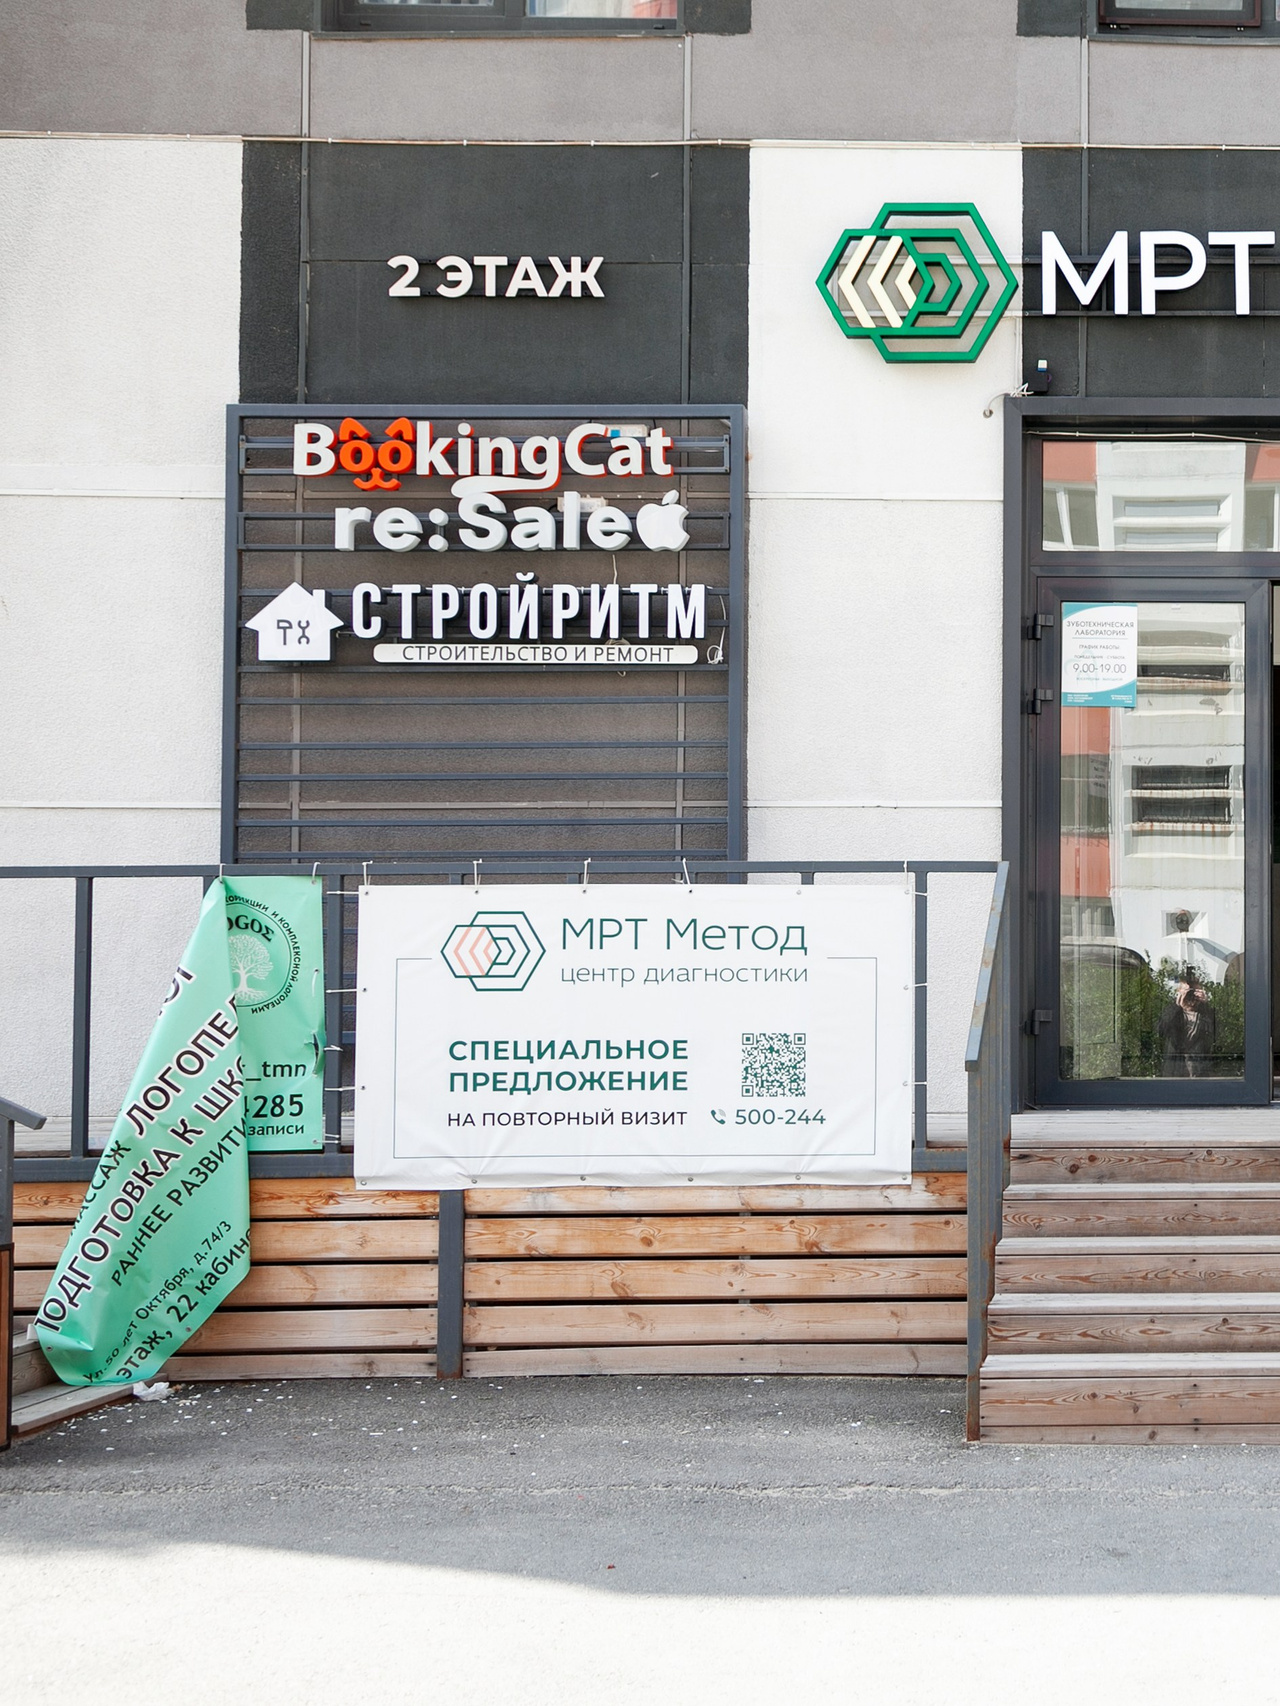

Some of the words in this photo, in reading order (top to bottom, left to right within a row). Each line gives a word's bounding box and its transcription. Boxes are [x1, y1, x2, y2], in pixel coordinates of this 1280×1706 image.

[387, 255, 421, 298] 2
[435, 255, 606, 299] ЭТАЖ
[1041, 230, 1276, 317] МРТ
[293, 417, 675, 497] BookingCat
[334, 490, 633, 552] re:Sale
[351, 571, 707, 641] СТРОЙРИТМ
[1066, 620, 1135, 628] ЗУБОТЕХНИЧЕСКАЯ
[402, 644, 568, 663] СТРОИТЕЛЬСТВО
[575, 645, 588, 662] И
[594, 646, 675, 662] РЕМОНТ
[278, 916, 301, 982] КОМПЛЕКСНОЙ
[561, 917, 648, 951] МРТ
[665, 917, 809, 956] Метод
[560, 966, 638, 988] центр
[644, 965, 809, 985] диагностики
[448, 1038, 689, 1062] СПЕЦИАЛЬНОЕ
[126, 995, 239, 1137] ЛОГОПЕ
[242, 1061, 307, 1082] _tmn
[448, 1069, 689, 1095] ПРЕДЛОЖЕНИЕ
[169, 1117, 204, 1146] К
[248, 1124, 305, 1136] записи
[447, 1112, 476, 1127] НА
[482, 1107, 615, 1127] ПОВТОРНЫЙ
[620, 1110, 688, 1126] ВИЗИТ
[735, 1108, 827, 1126] 500-244
[111, 1204, 174, 1286] РАННЕЕ
[135, 1267, 195, 1320] Октября,
[166, 1293, 199, 1323] 22
